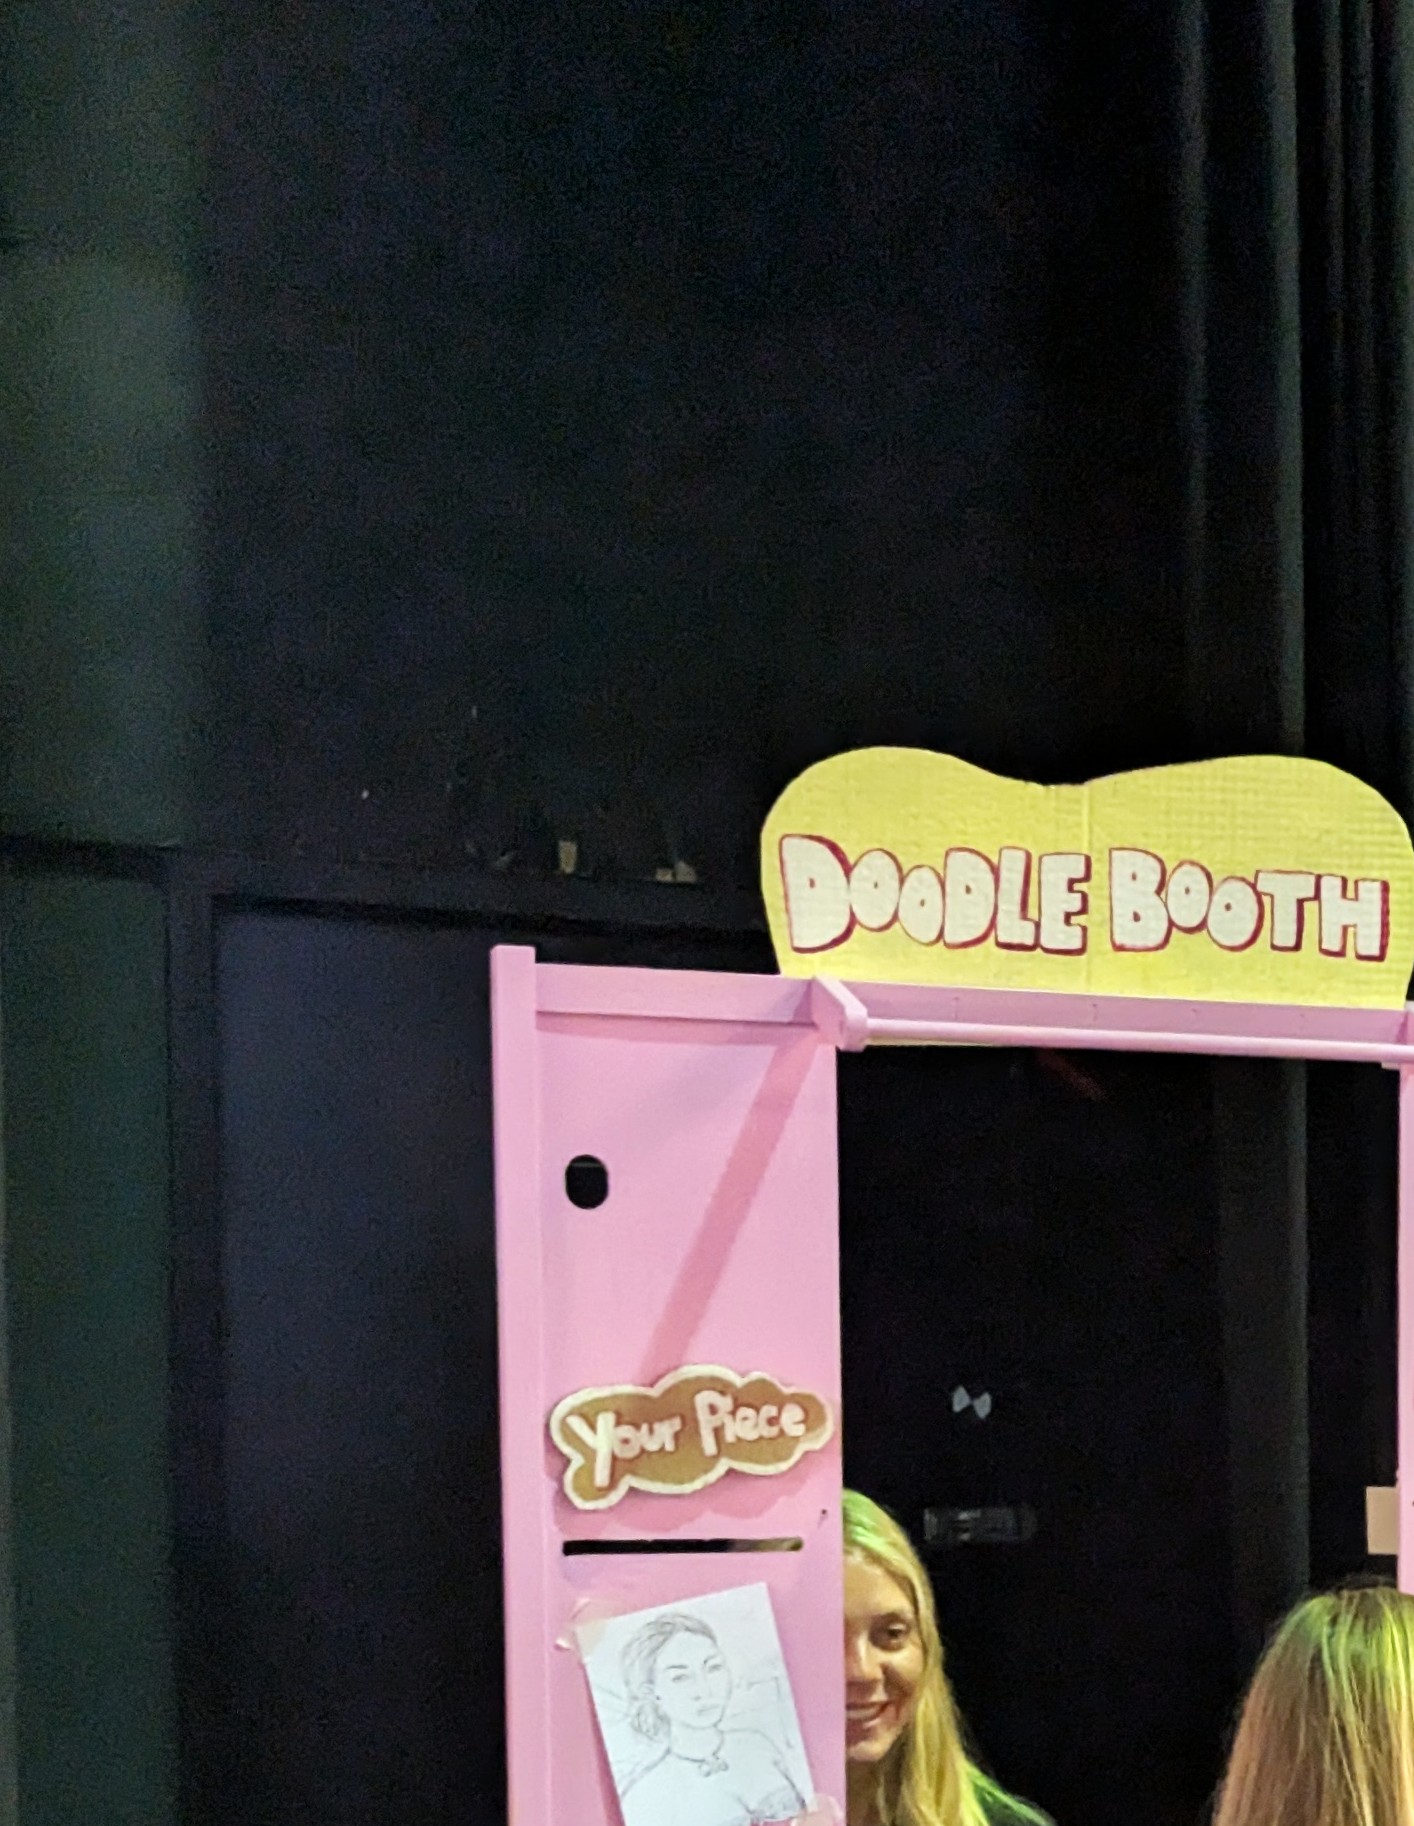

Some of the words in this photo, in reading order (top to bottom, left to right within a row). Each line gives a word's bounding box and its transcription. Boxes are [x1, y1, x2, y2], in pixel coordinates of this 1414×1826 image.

[779, 834, 1091, 956] DOODLE
[1108, 847, 1390, 962] BOOTH
[565, 1411, 682, 1488] Your
[694, 1390, 807, 1457] Piece
